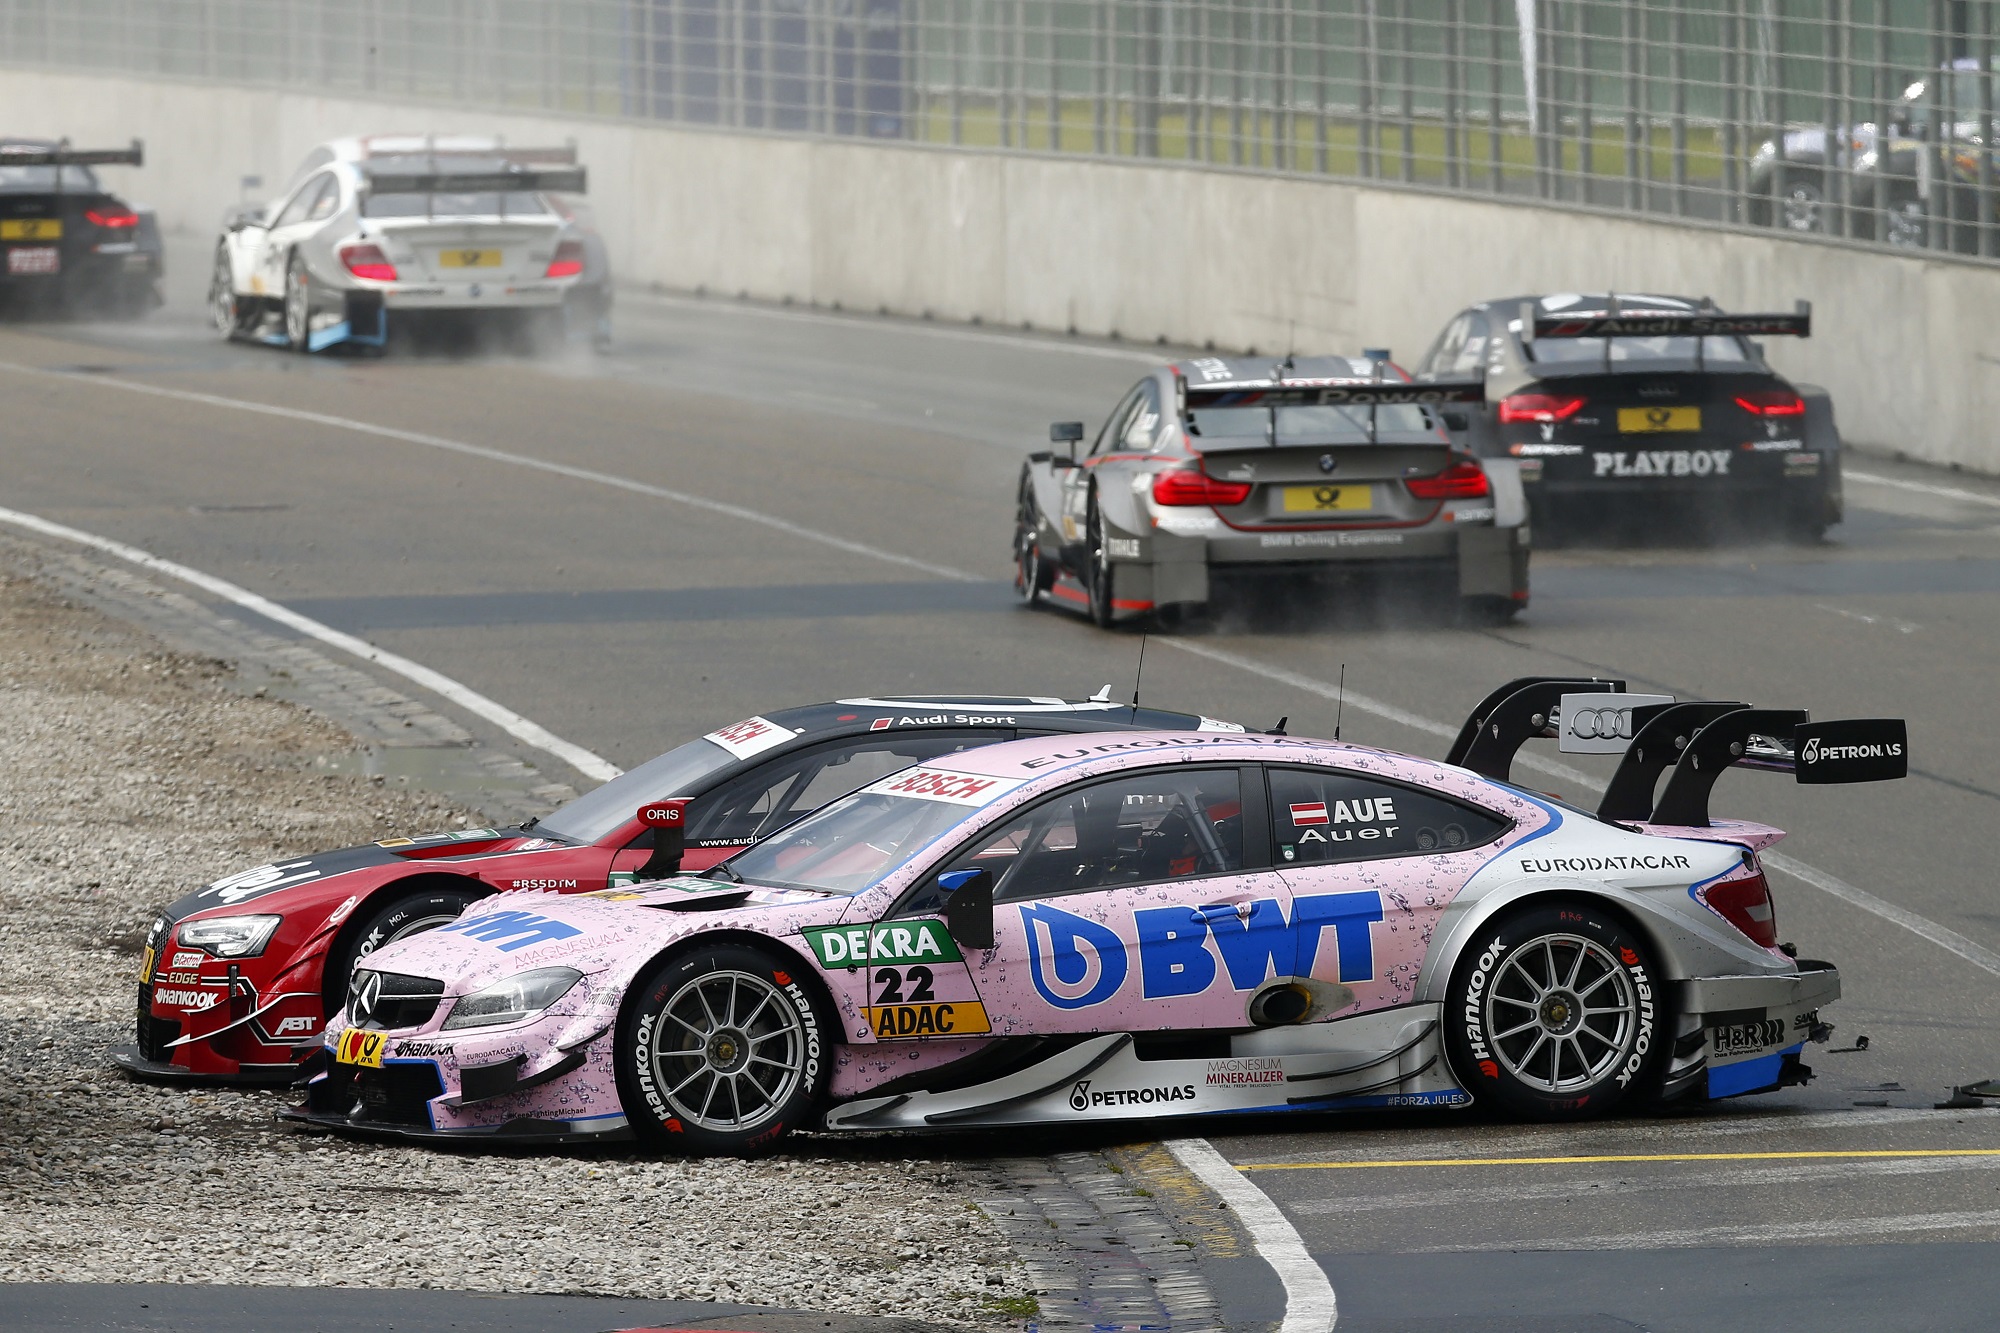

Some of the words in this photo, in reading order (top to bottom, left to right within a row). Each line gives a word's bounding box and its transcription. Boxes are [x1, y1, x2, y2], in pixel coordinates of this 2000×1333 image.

[1593, 450, 1732, 477] PLAYBOY
[1294, 534, 1337, 548] Driving
[899, 714, 948, 725] Audi
[955, 714, 1016, 726] Sport
[889, 773, 998, 798] BOSCH
[646, 809, 679, 820] ORIS
[1334, 797, 1397, 824] AUE
[700, 835, 763, 847] www.audi-
[1298, 826, 1400, 844] Auer
[1520, 855, 1691, 873] EURODATACAR
[821, 926, 942, 962] DEKRA
[1132, 889, 1385, 1001] BWT
[168, 971, 199, 985] EDGE
[874, 965, 935, 1004] 22
[274, 1016, 317, 1036] ABT
[878, 1005, 954, 1036] ADAC
[1713, 1023, 1762, 1052] H&R
[466, 1046, 517, 1060] EURODATACAR
[1207, 1059, 1282, 1073] MAGNESIUM
[1206, 1070, 1283, 1084] MINERALIZER
[1091, 1085, 1196, 1107] PETRONAS
[1387, 1096, 1431, 1106] #FORZA
[1432, 1094, 1465, 1105] JULES
